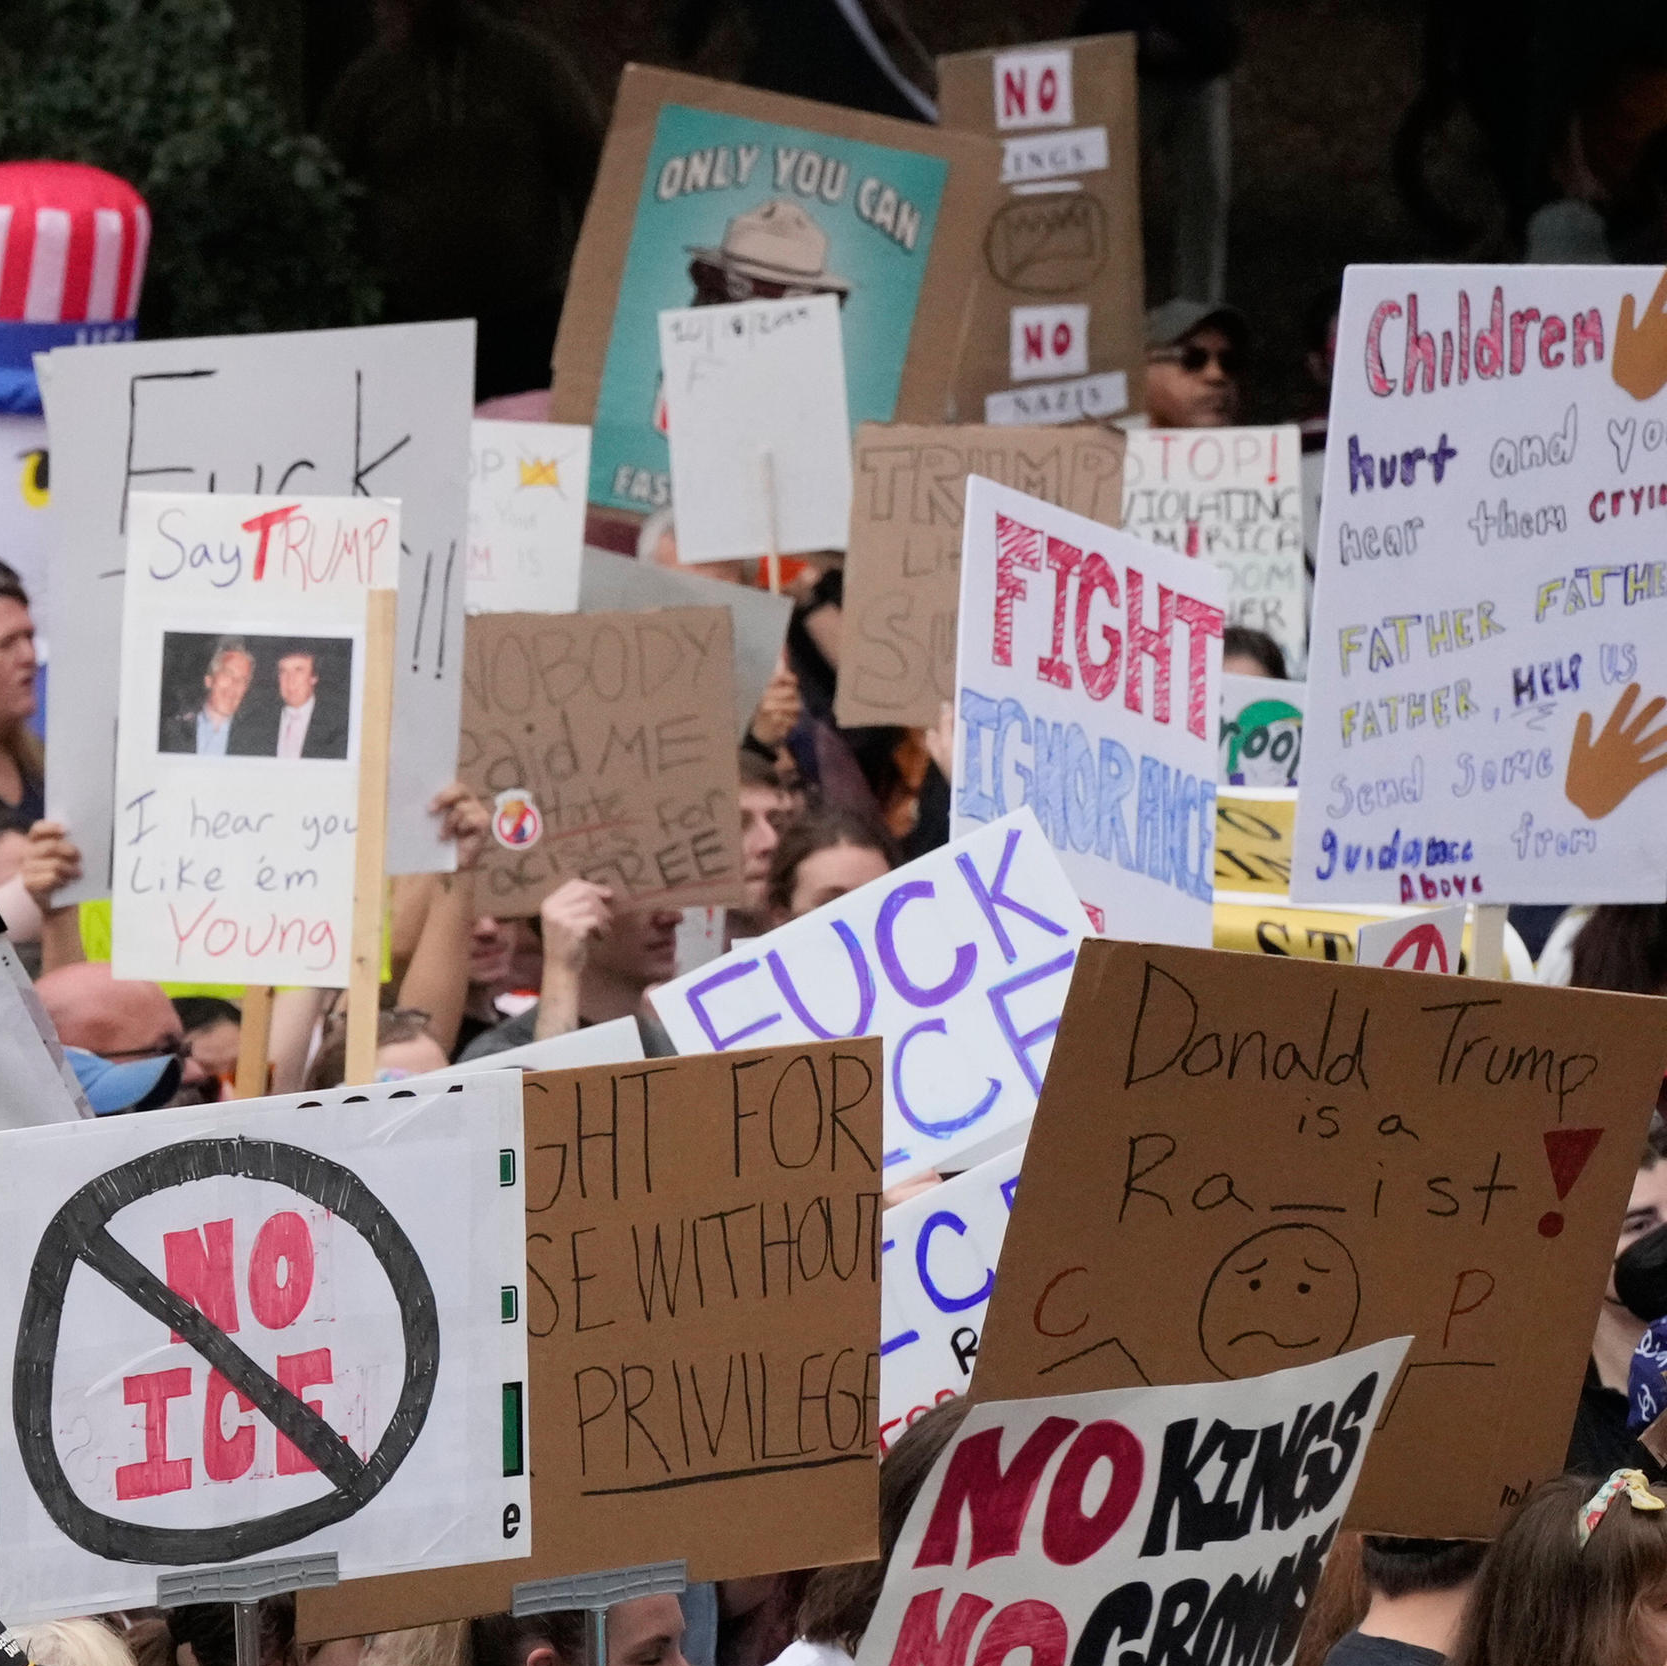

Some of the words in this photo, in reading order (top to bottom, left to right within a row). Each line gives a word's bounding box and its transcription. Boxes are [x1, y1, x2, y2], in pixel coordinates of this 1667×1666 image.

[1003, 67, 1057, 118] NO
[658, 146, 759, 201] ONLY
[773, 147, 849, 200] YOU
[857, 178, 920, 250] CAN
[1022, 323, 1072, 363] NO
[1366, 286, 1604, 397] Children
[1348, 433, 1458, 495] hurt
[1490, 402, 1578, 479] and
[150, 508, 243, 586] Say
[242, 504, 389, 592] TRUMP
[1339, 518, 1424, 566] hear
[1468, 499, 1567, 547] them
[992, 511, 1224, 740] FIGHT
[1339, 602, 1505, 676] FATHER
[597, 714, 709, 780] ME
[958, 685, 1216, 903] IGNORANCE
[190, 796, 275, 836] hear
[1316, 829, 1473, 881] guidance
[169, 898, 337, 969] Young
[687, 830, 1068, 1050] FUCK
[1125, 962, 1369, 1090] Donald
[1420, 1002, 1600, 1124] Trump
[731, 1052, 875, 1175] FOR
[1296, 1094, 1342, 1139] is
[163, 1209, 319, 1345] NO
[632, 1190, 883, 1325] WITHOUT
[115, 1346, 335, 1502] ICE
[914, 1415, 1144, 1569] NO
[1140, 1370, 1380, 1558] KINGS
